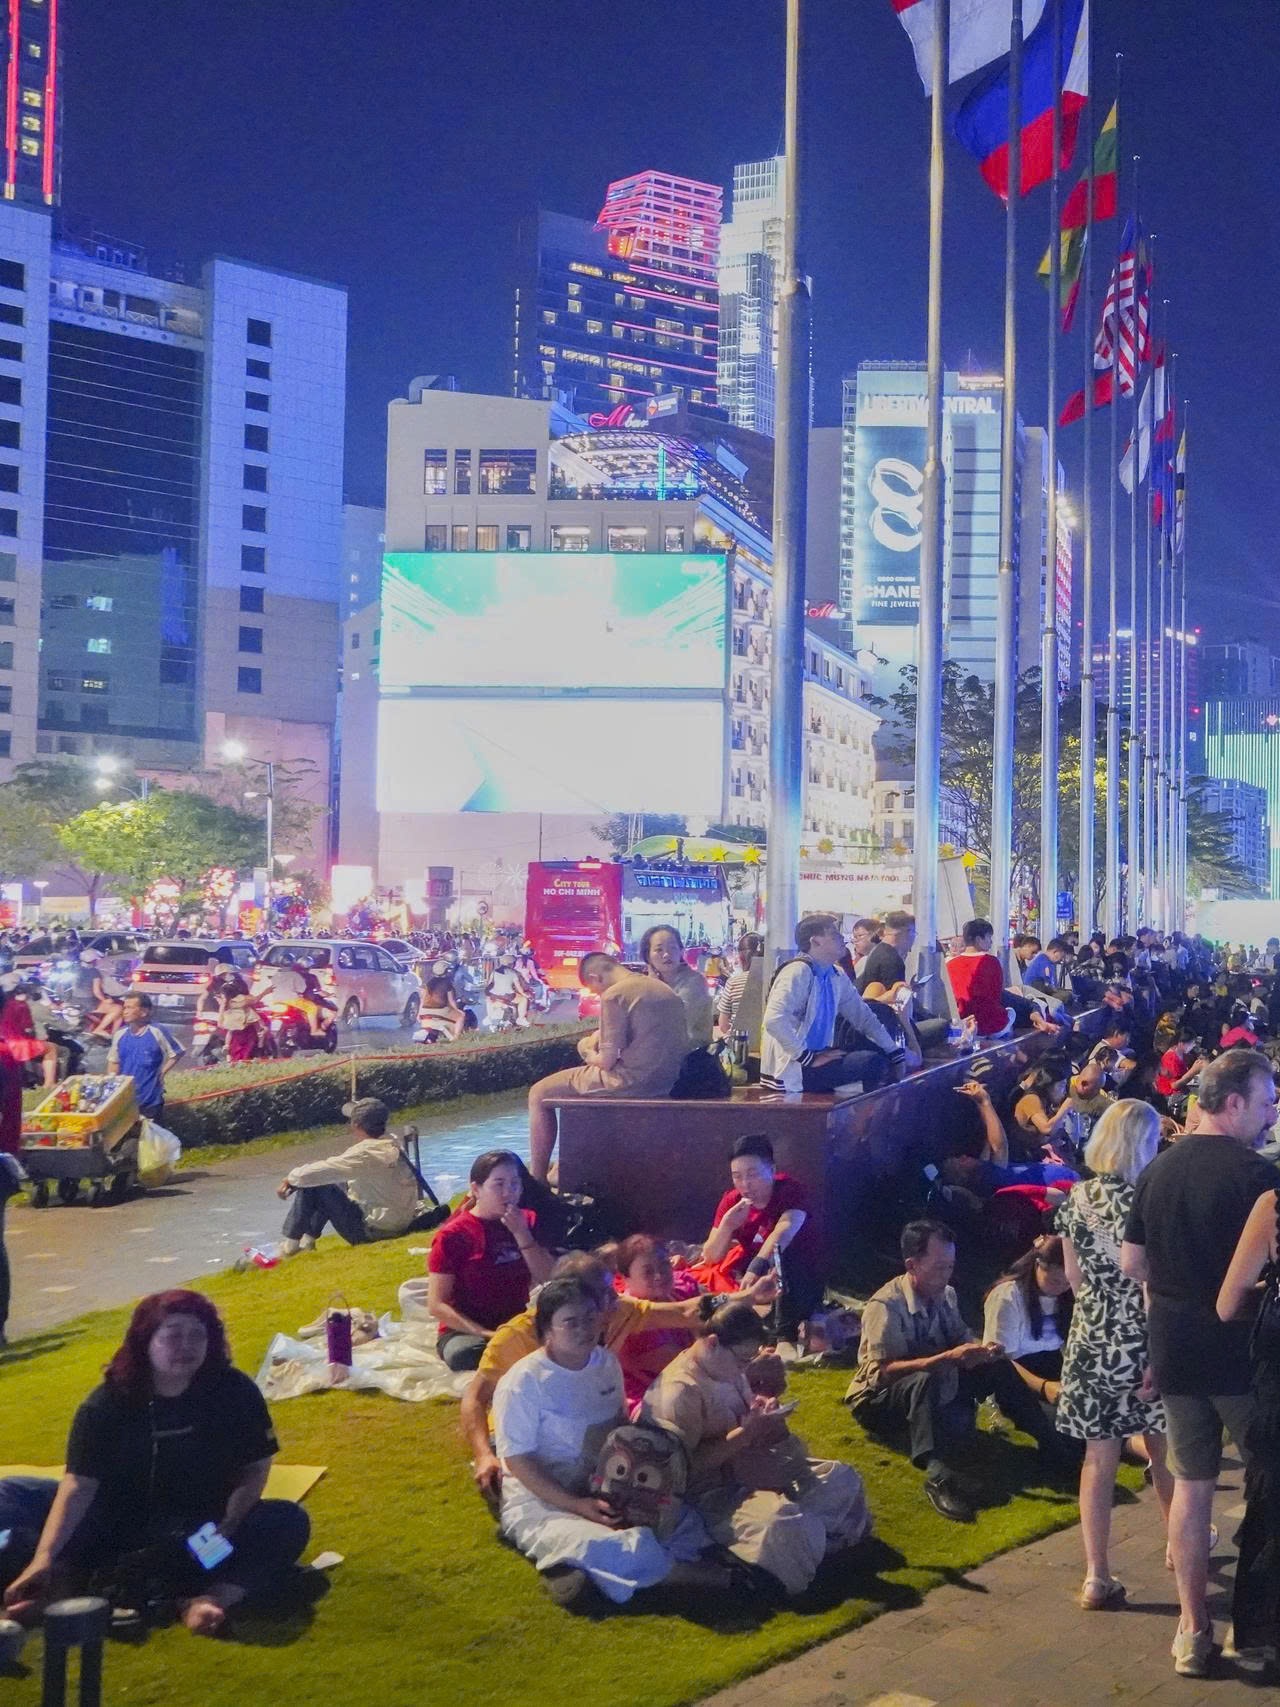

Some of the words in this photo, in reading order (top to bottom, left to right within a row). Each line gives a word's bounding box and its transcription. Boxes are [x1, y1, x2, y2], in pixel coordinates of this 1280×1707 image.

[863, 585, 921, 599] CHANE
[558, 888, 574, 896] CHI
[576, 888, 601, 896] MINH
